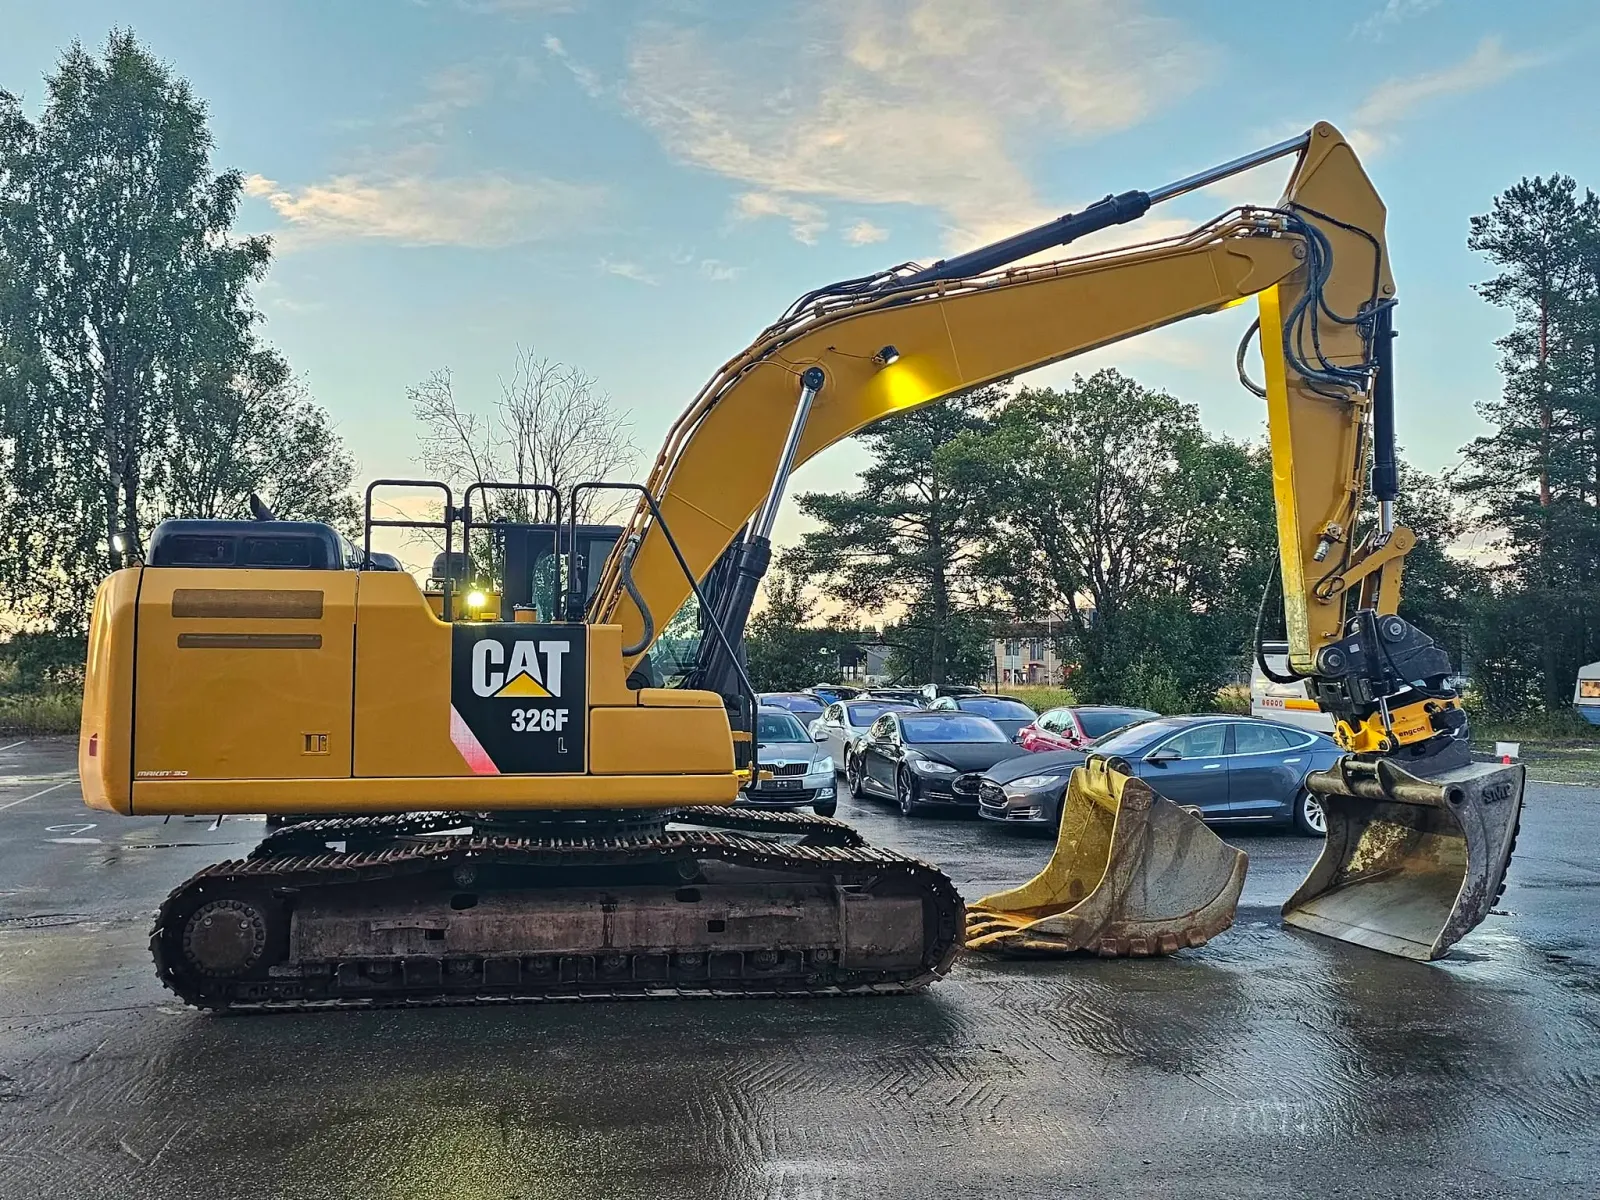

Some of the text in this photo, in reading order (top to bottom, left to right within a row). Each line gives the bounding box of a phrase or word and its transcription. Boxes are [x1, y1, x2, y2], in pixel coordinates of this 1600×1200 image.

[472, 638, 570, 698] CAT
[511, 708, 569, 732] 326F
[1399, 725, 1426, 737] engcon
[557, 736, 568, 754] L
